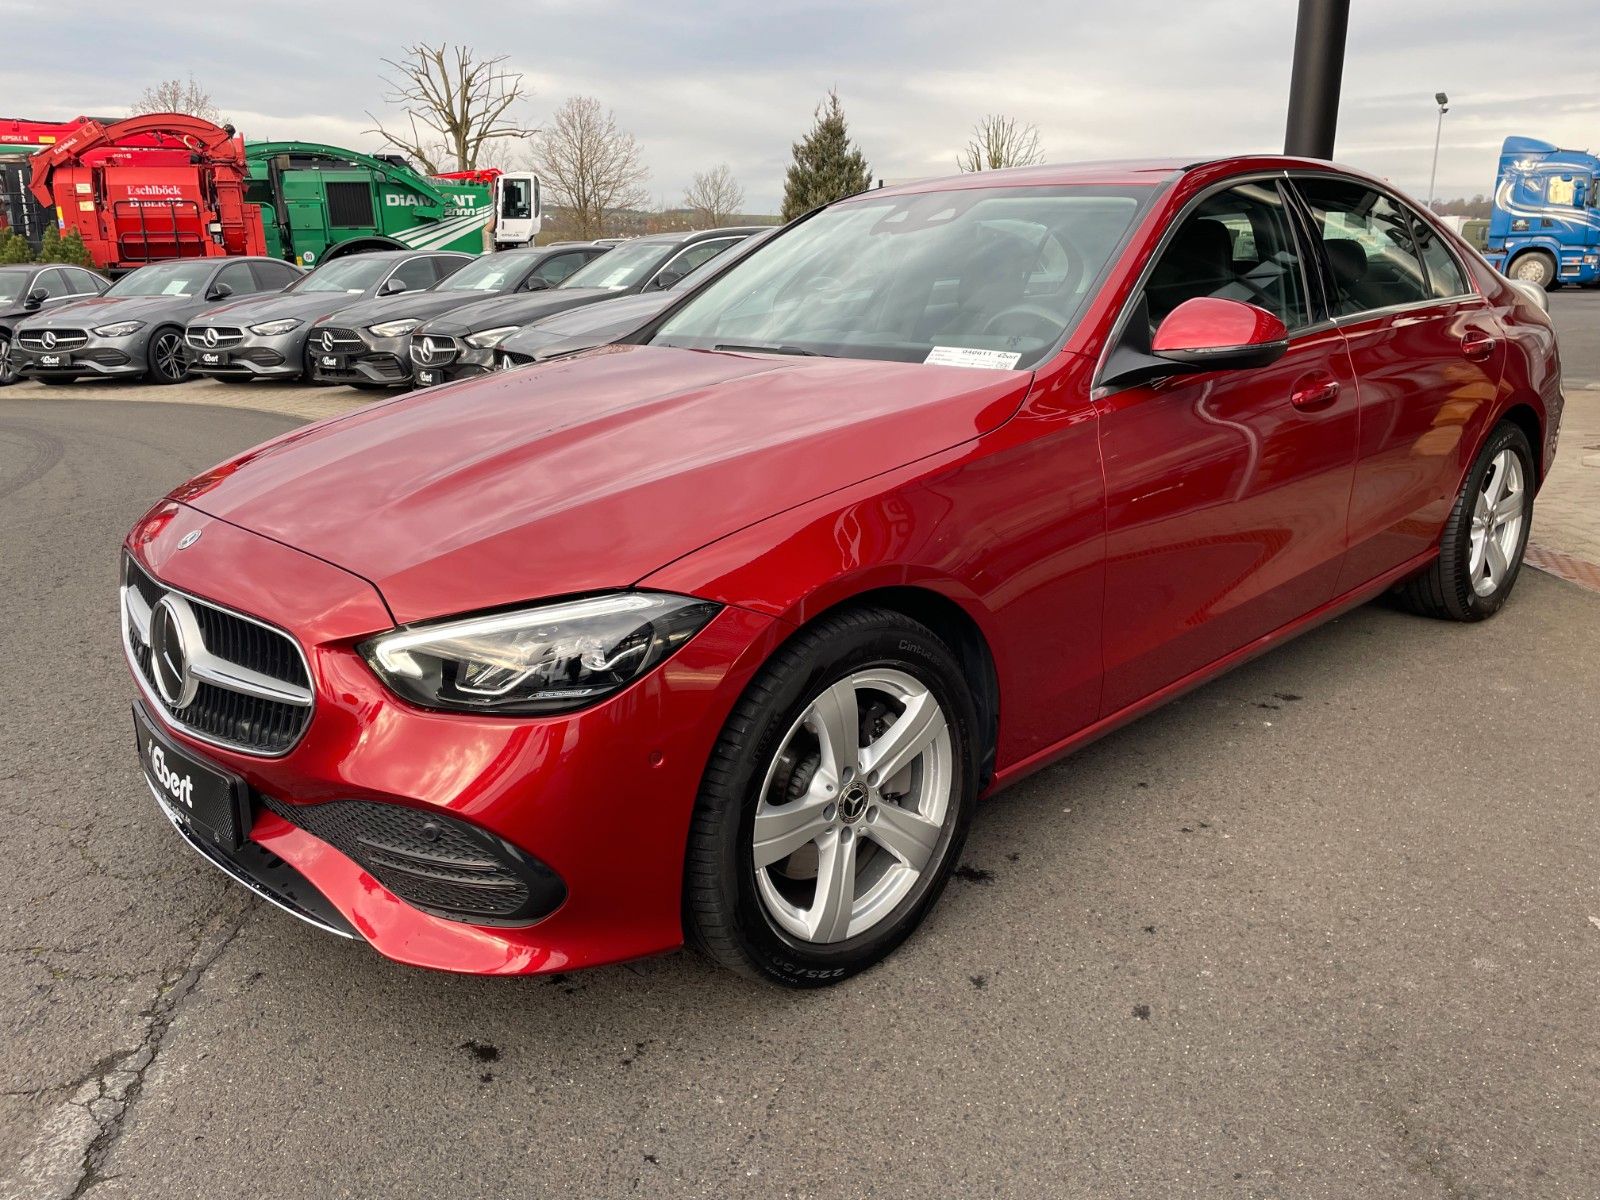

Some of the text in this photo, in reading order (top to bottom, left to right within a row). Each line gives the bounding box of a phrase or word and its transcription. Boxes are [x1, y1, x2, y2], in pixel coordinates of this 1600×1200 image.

[127, 185, 182, 195] Eschlböck
[386, 194, 477, 207] DiAMNT
[444, 208, 476, 216] 2000
[152, 745, 194, 809] Ebert
